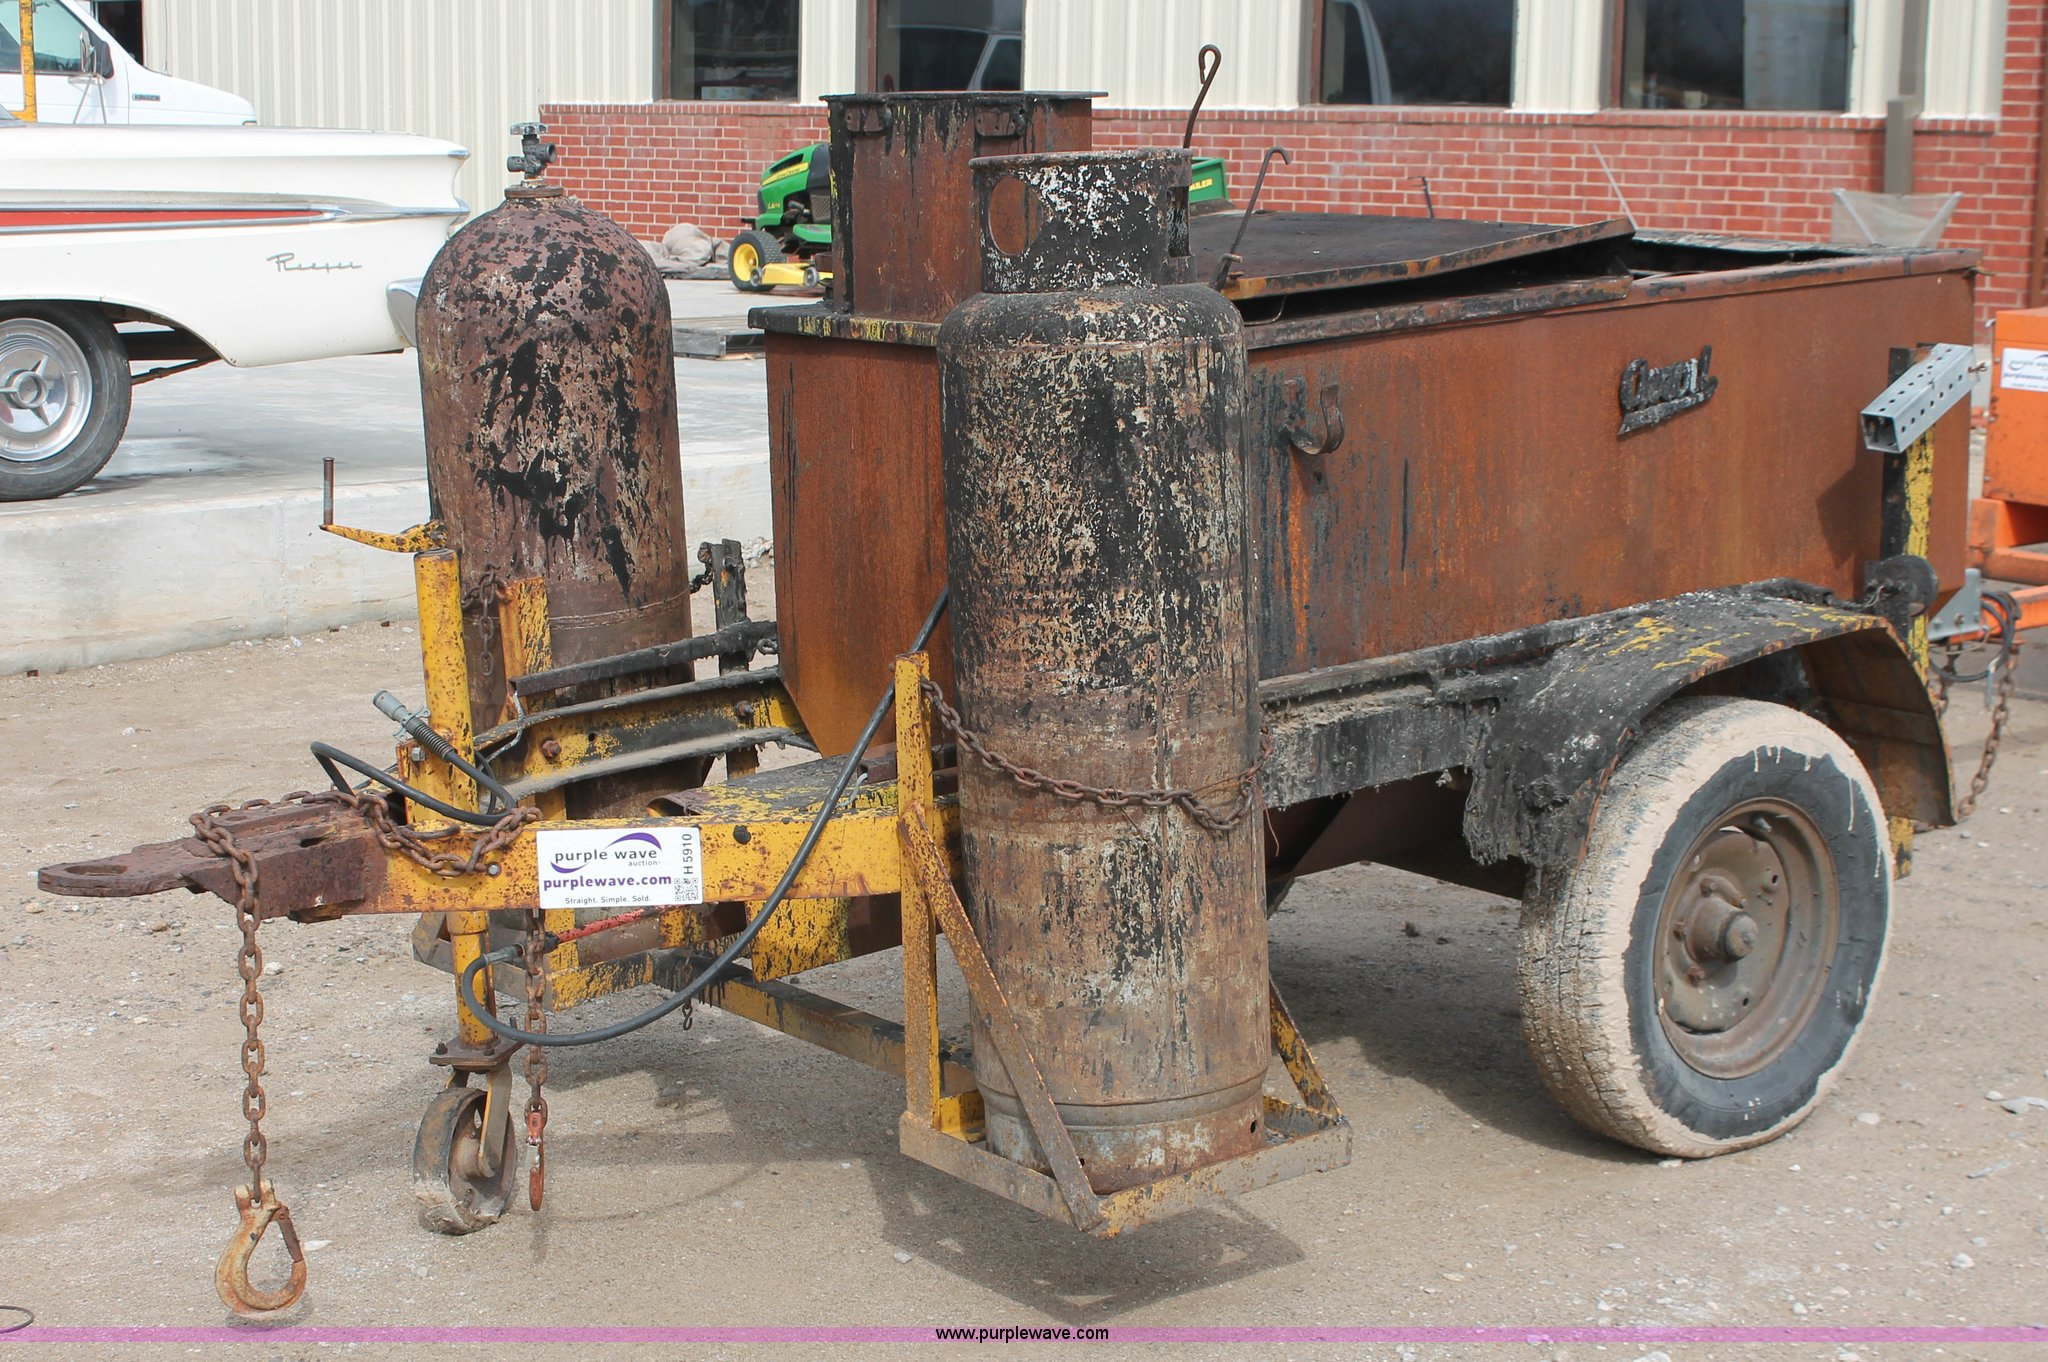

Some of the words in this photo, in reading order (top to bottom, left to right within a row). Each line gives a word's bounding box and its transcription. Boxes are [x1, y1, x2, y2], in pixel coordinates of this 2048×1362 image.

[555, 849, 608, 864] purple
[615, 849, 658, 860] wave
[543, 875, 672, 892] purplewave.com
[565, 896, 598, 905] Straight.
[600, 895, 630, 904] Simple.
[632, 894, 652, 903] Sold.
